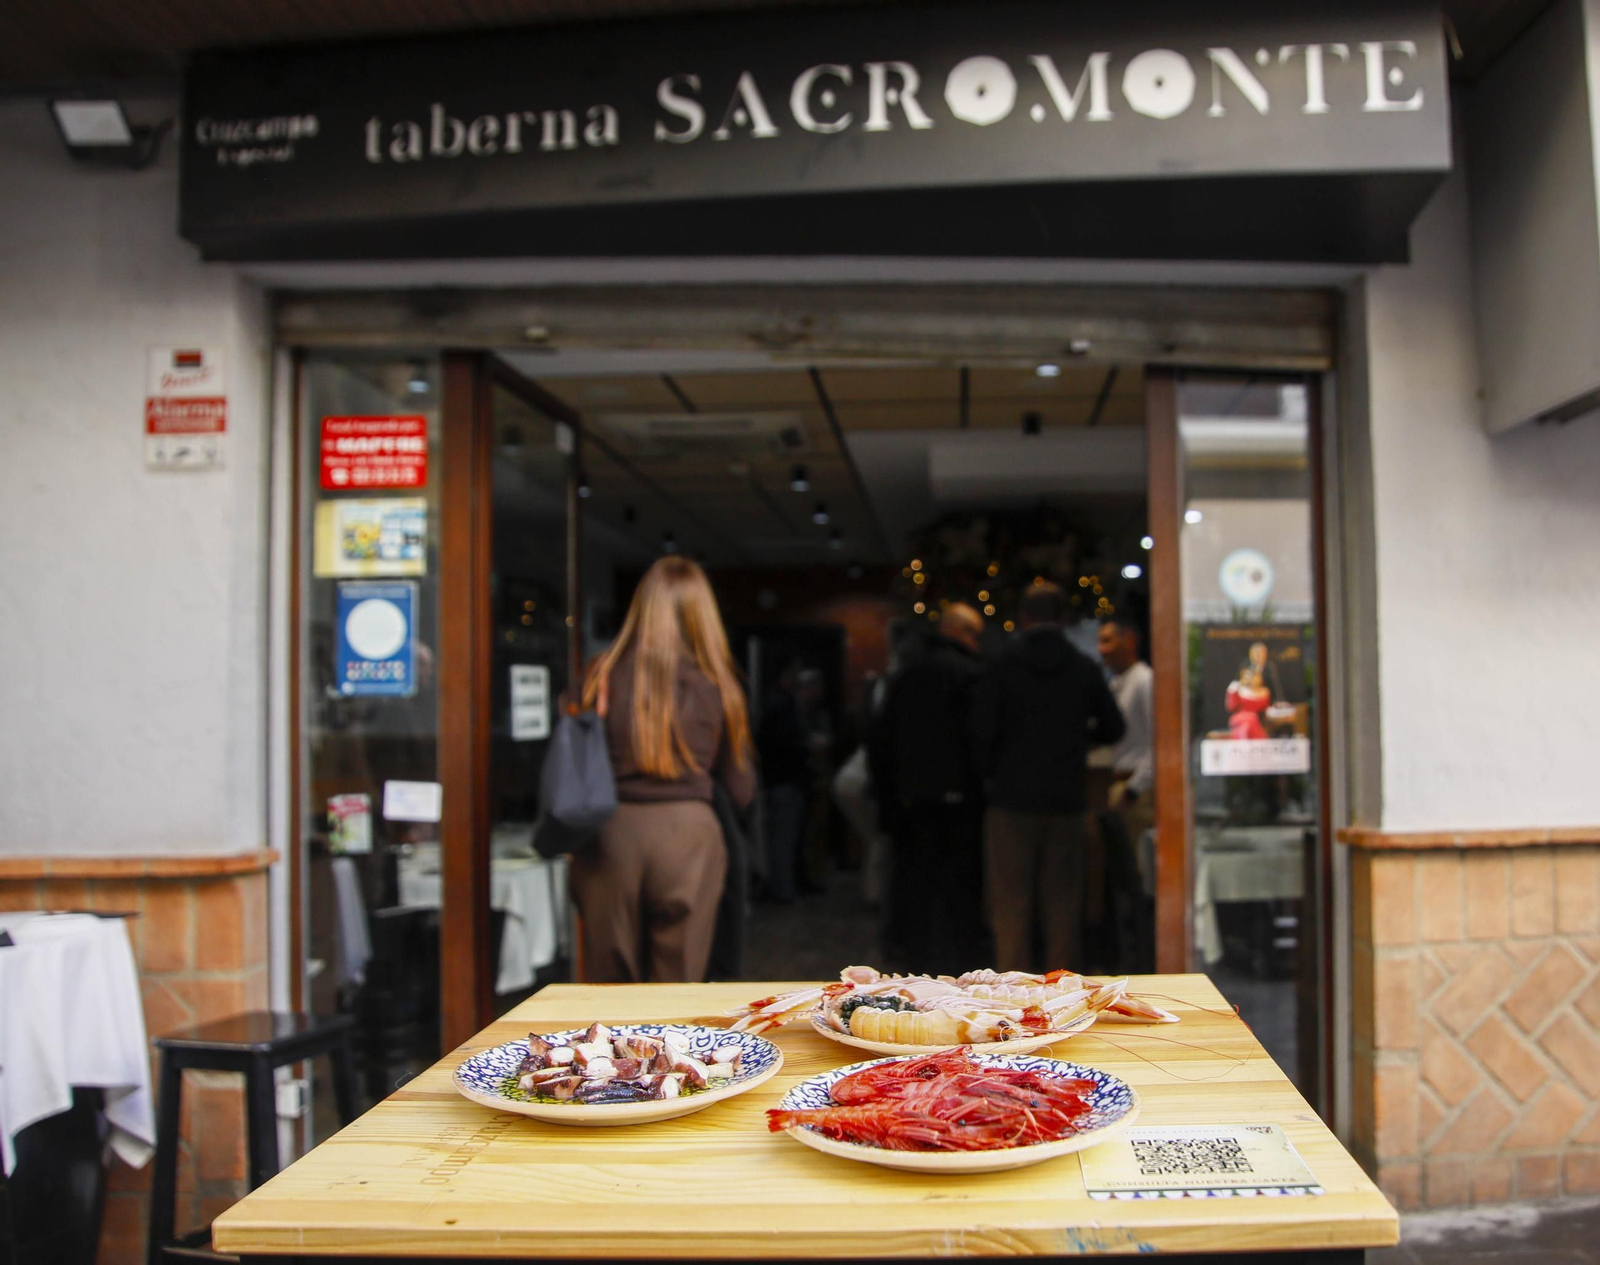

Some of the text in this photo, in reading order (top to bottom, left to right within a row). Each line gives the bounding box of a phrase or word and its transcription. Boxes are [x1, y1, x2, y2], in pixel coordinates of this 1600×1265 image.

[363, 39, 1425, 163] taberna SACROMONTE
[1106, 1176, 1298, 1188] CONSULTA NUESTRA CARTA
